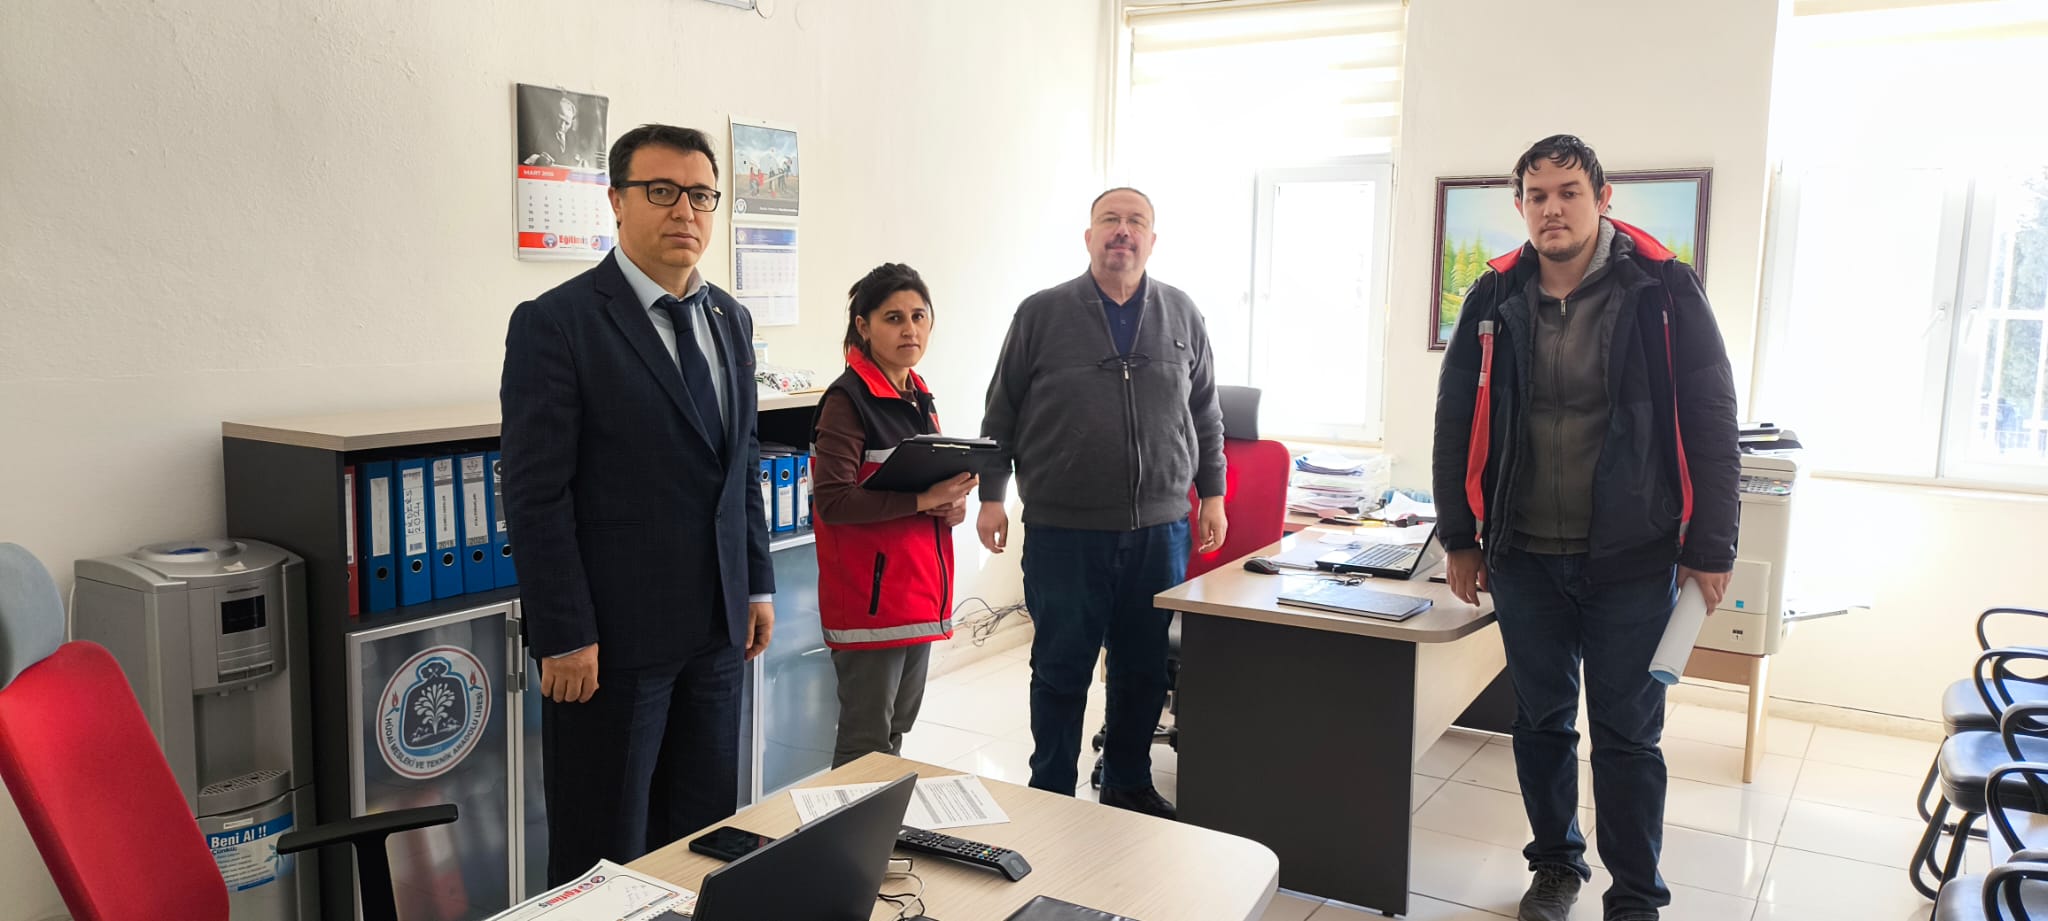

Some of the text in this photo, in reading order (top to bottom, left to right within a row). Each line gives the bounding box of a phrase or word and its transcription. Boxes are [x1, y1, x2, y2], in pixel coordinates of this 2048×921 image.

[453, 719, 479, 756] ANADOLU
[211, 825, 267, 848] Beni Al !!
